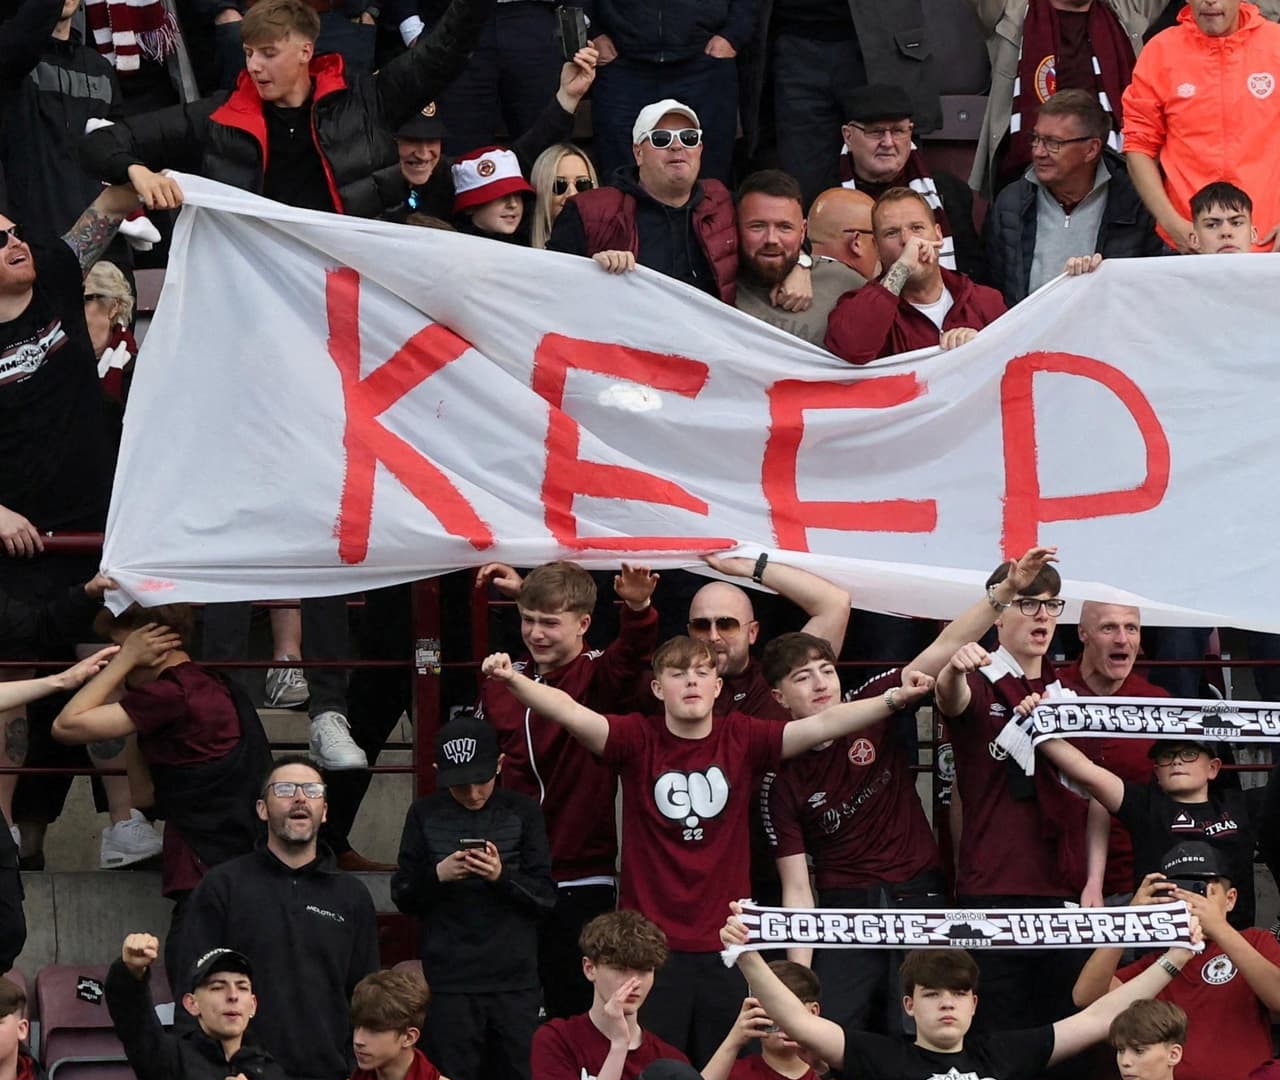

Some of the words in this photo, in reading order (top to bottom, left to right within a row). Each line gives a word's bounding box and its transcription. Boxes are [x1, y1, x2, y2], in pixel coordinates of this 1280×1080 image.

[325, 267, 1170, 564] KEEP
[1032, 705, 1188, 733] GORGIE
[654, 766, 729, 819] GU
[683, 828, 703, 840] 22
[759, 912, 932, 945] GORGIE
[1006, 911, 1178, 944] ULTRAS
[946, 912, 988, 921] GLORIOUS
[949, 938, 992, 948] HEARTS
